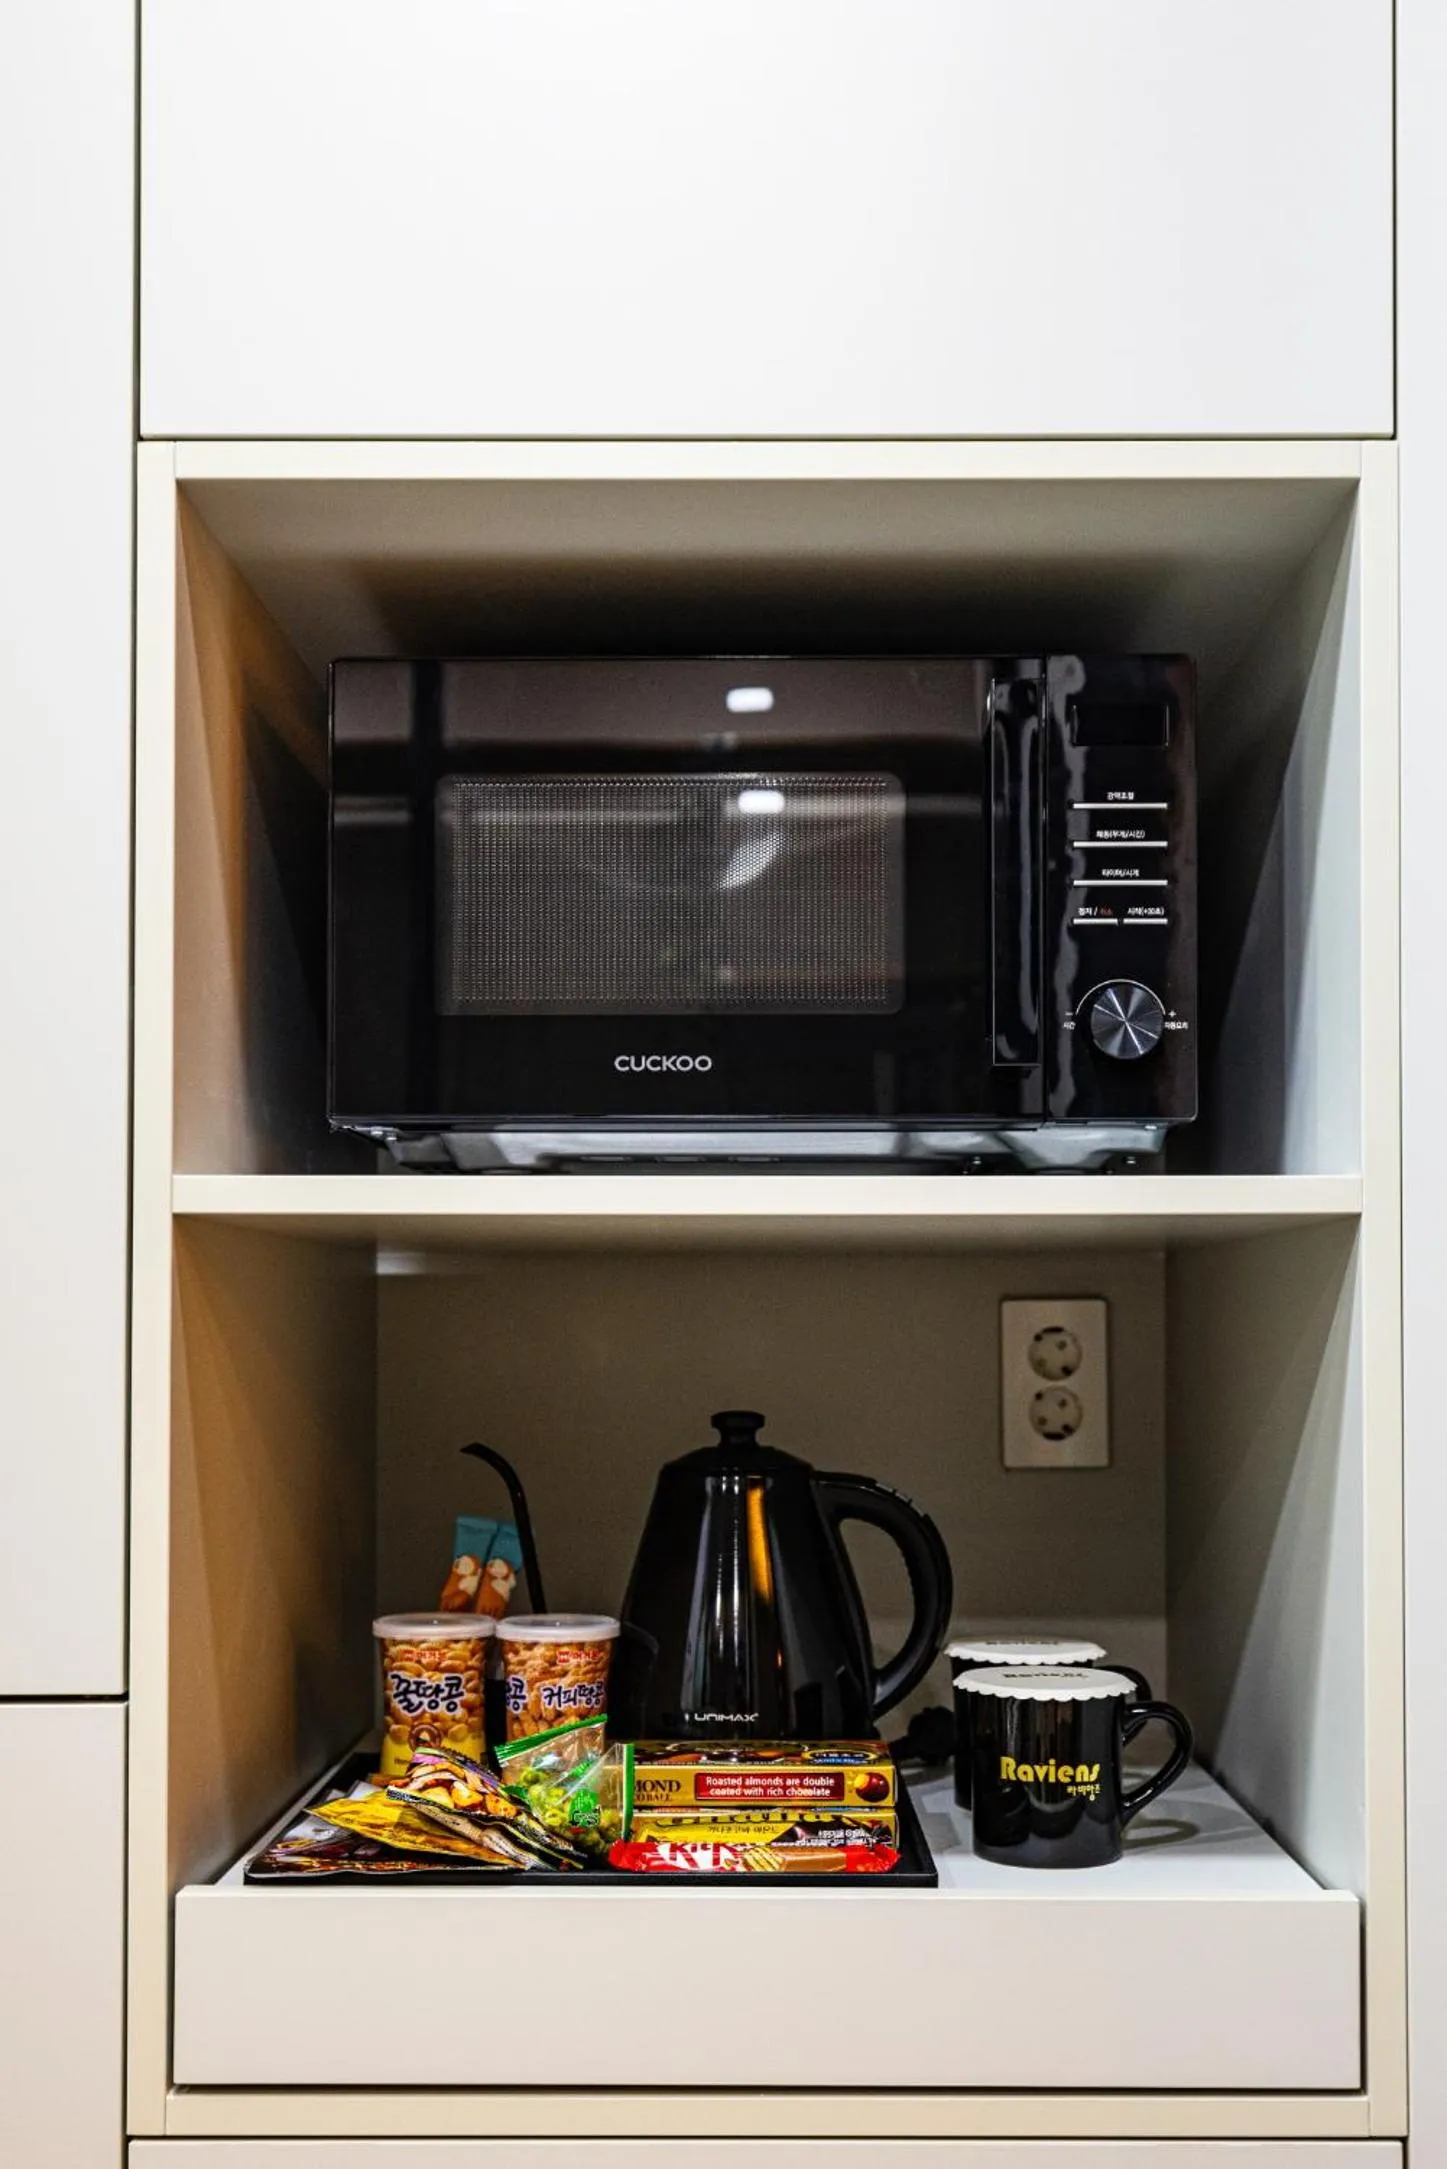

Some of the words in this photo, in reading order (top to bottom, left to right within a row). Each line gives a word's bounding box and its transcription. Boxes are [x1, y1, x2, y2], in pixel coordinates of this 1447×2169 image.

[613, 1054, 713, 1072] CUCKOO
[390, 1673, 465, 1714] 꿀땅콩
[543, 1681, 604, 1708] 커피땅콩
[1000, 1756, 1101, 1784] Raviens
[706, 1776, 743, 1787] Roasted
[745, 1776, 783, 1787] almonds
[786, 1778, 801, 1787] are
[803, 1776, 835, 1787] double
[709, 1787, 741, 1797] coated
[742, 1787, 764, 1797] with
[767, 1787, 785, 1797] rich
[786, 1787, 831, 1797] chocolate
